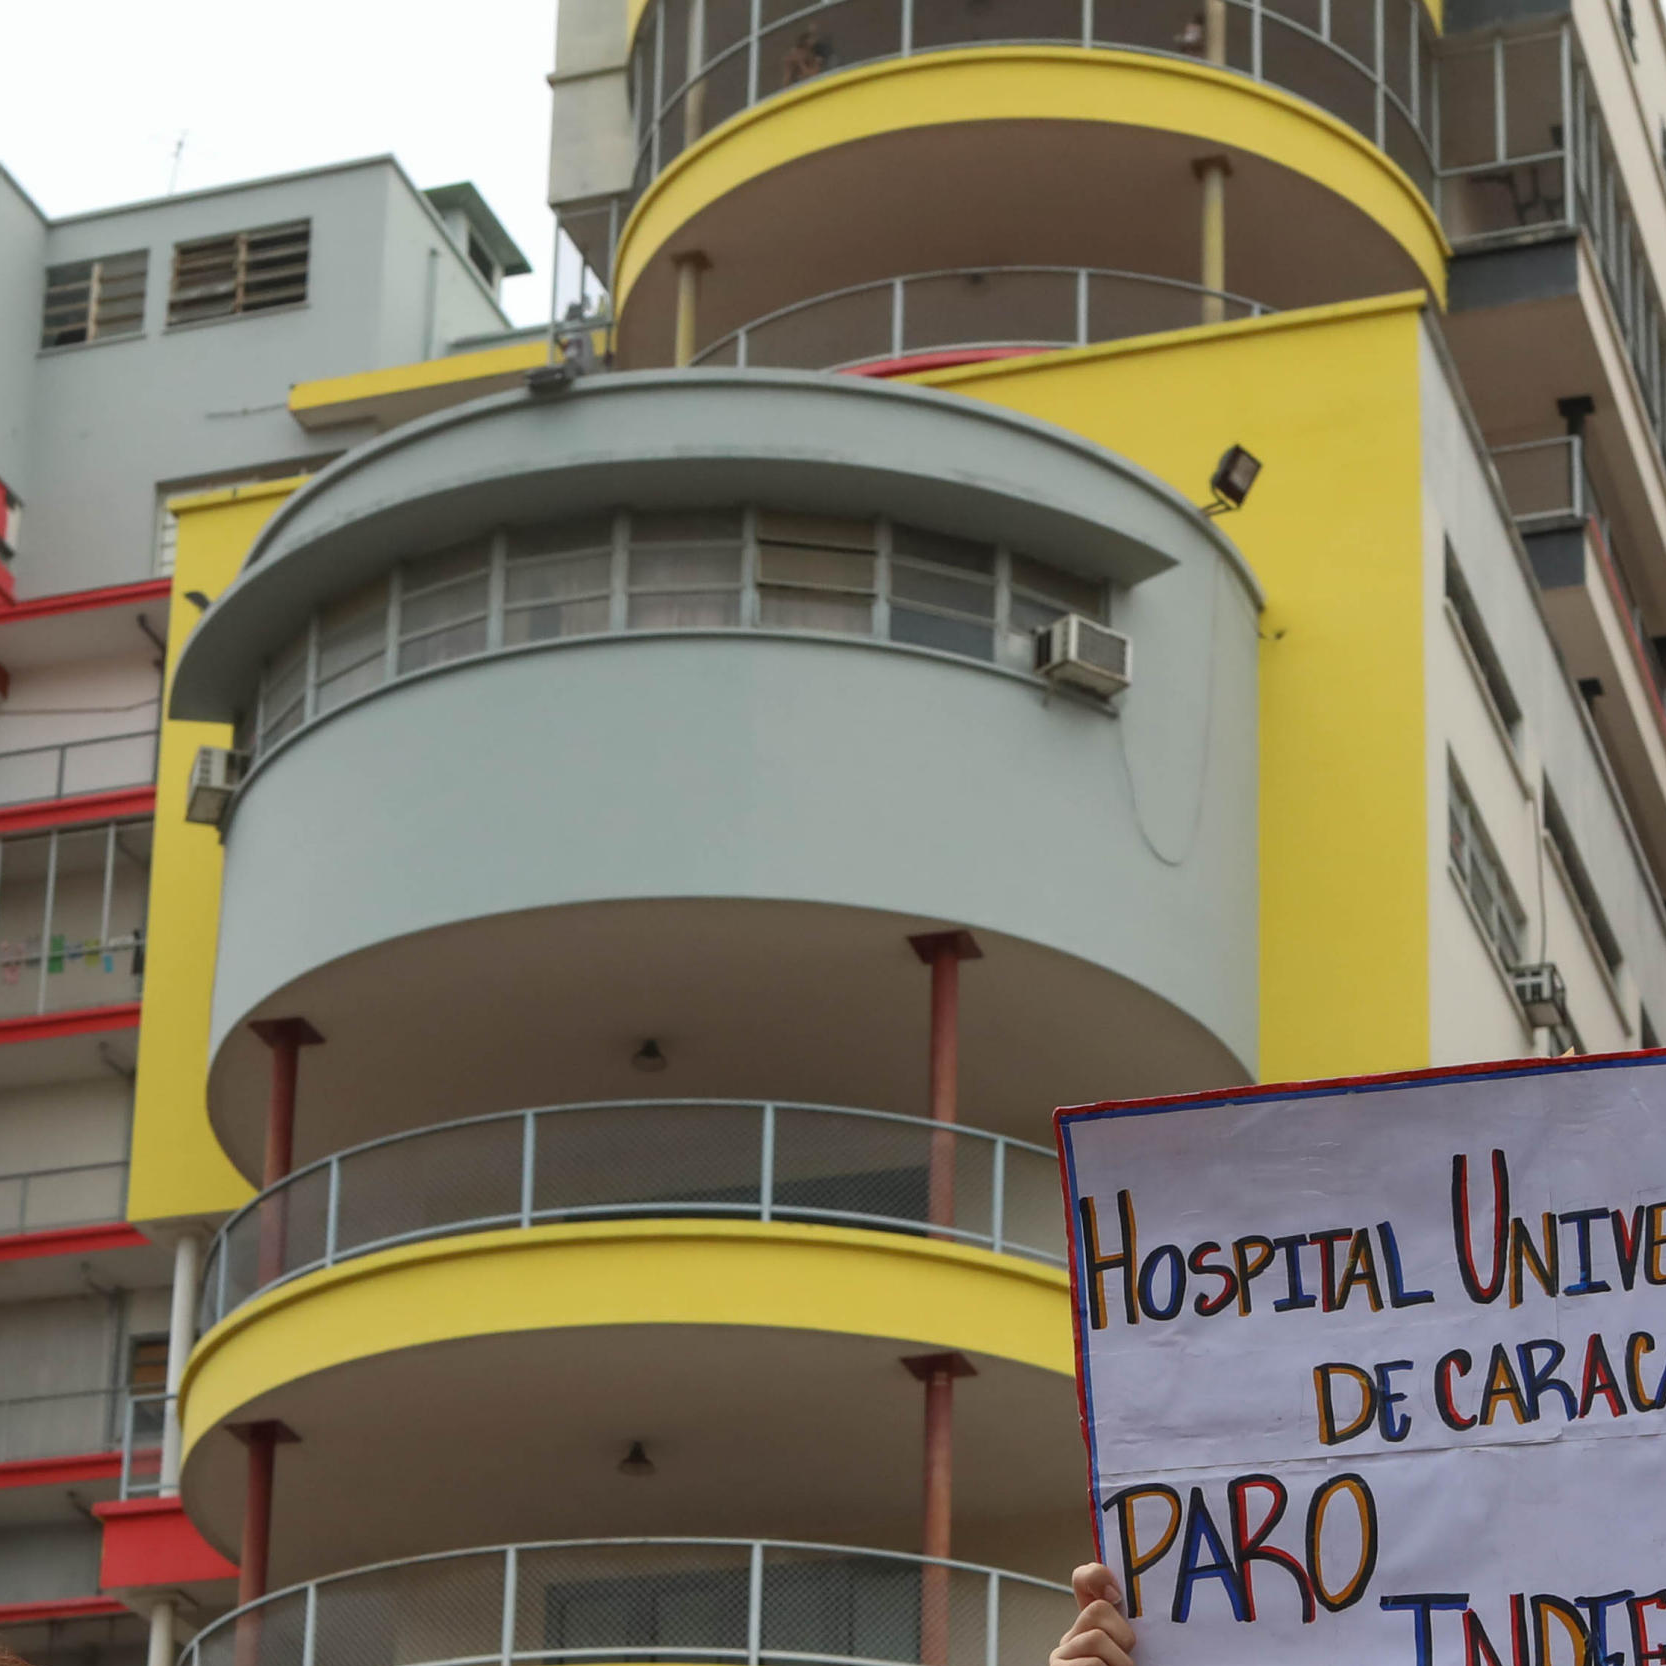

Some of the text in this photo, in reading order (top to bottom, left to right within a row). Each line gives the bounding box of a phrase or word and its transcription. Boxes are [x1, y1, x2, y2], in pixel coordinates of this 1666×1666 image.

[1081, 1190, 1434, 1329] HOSPITAL
[1313, 1361, 1414, 1444] DE
[1101, 1473, 1380, 1624] PARO
